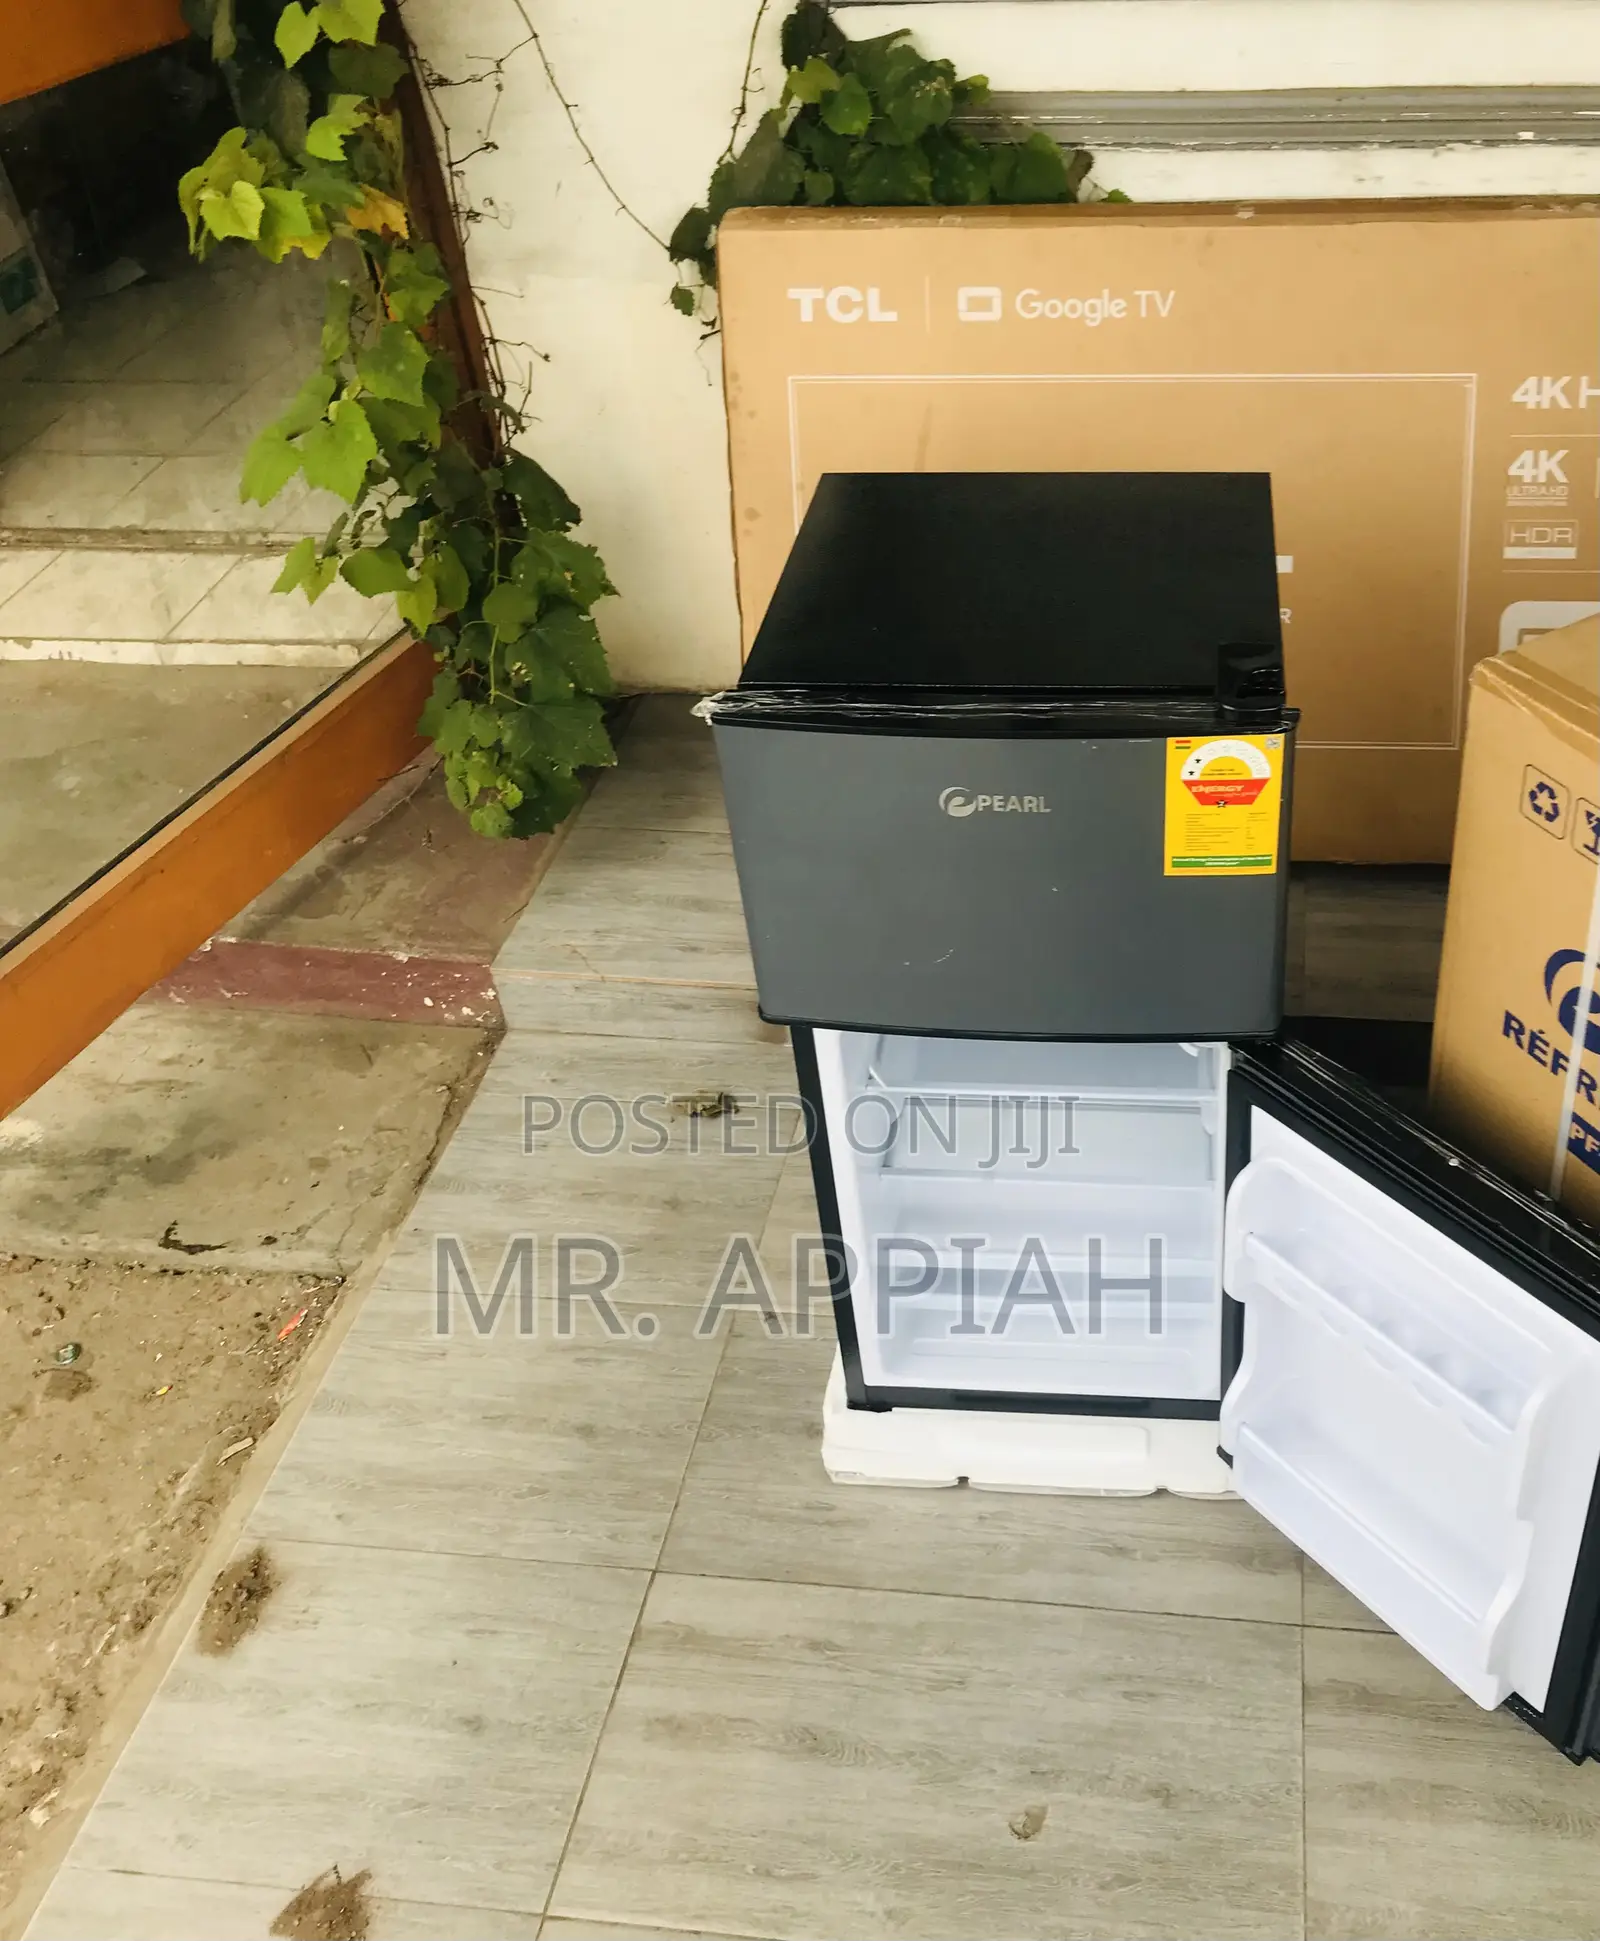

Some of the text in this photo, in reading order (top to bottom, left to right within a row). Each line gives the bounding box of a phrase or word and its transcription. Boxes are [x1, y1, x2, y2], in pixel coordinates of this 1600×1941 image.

[786, 286, 898, 323] TCL
[1014, 288, 1177, 327] Google TV
[1511, 375, 1573, 410] 4K
[1507, 449, 1570, 483] 4K
[1510, 526, 1573, 543] HDR
[976, 794, 1053, 813] PEARL
